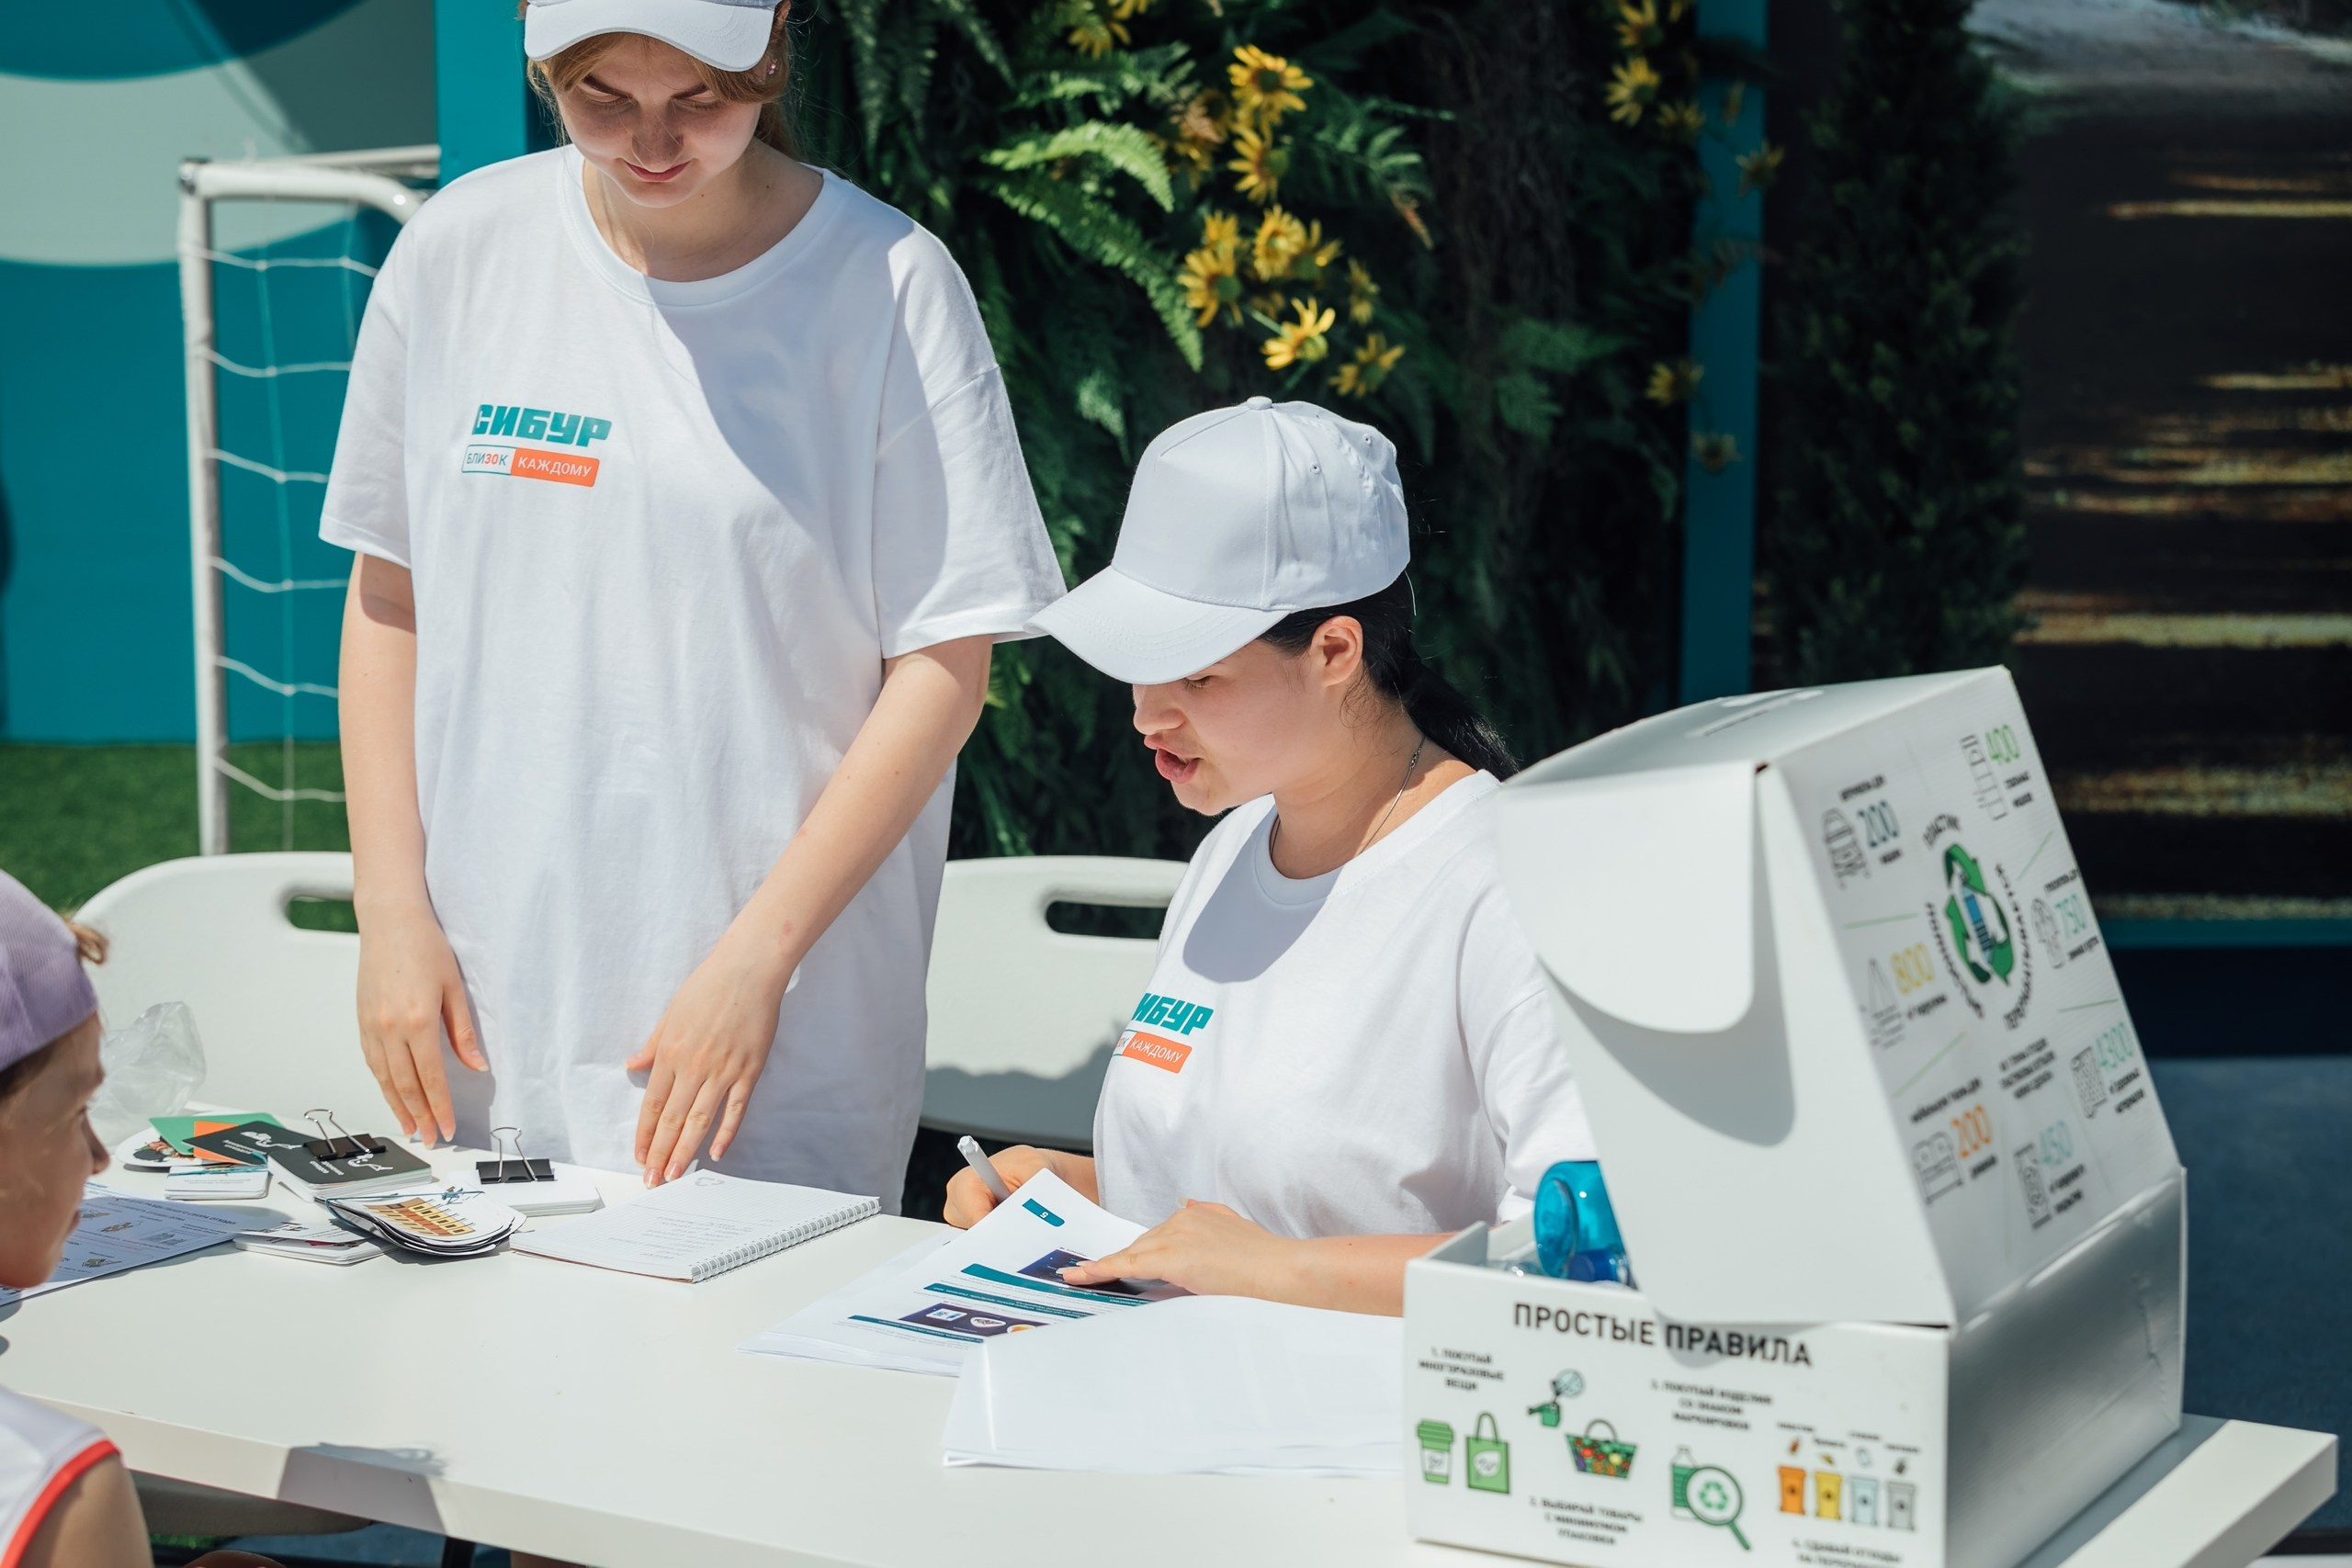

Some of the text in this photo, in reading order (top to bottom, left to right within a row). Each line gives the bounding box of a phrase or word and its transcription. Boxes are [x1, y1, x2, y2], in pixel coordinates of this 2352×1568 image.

[471, 404, 612, 447] СИБУР
[467, 453, 592, 478] БЛИЗОК КАЖДОМУ
[1985, 724, 2020, 763] 400
[1858, 800, 1900, 847] 200
[2053, 893, 2088, 940] 750
[1891, 942, 1935, 995] 800
[1132, 993, 1214, 1035] ИБУР
[1130, 1039, 1183, 1063] КАЖДОМУ
[1951, 1104, 1993, 1158] 200
[1514, 1303, 1813, 1367] ПРОСТЫЕ ПРАВИЛА
